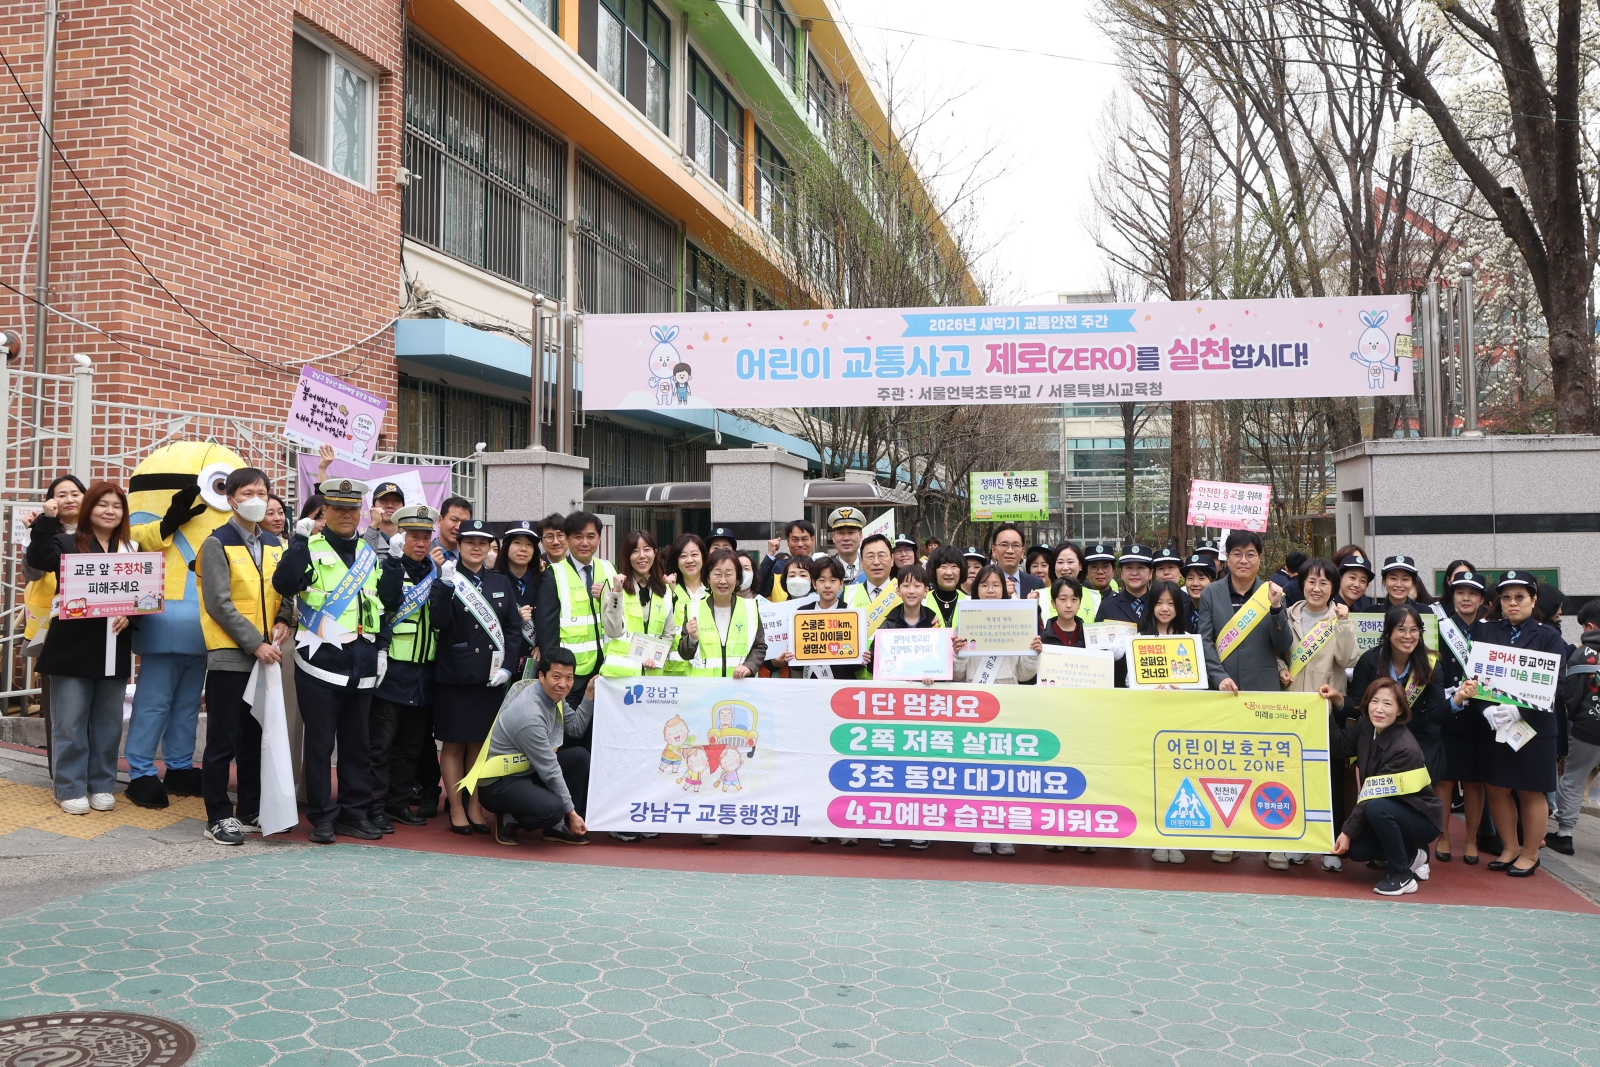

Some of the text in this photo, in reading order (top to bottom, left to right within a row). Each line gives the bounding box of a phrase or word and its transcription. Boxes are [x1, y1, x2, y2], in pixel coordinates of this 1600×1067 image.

[929, 314, 1108, 333] 2026년 새학기 교통안전 주간
[735, 337, 1309, 381] 어린이 교통사고 제로(ZERO)를 실천합시다!
[302, 385, 338, 411] 붕어빵엔
[877, 387, 905, 401] 주관
[918, 385, 1031, 401] 서울언북초등학교
[1048, 382, 1163, 398] 서울특별시교육청
[981, 478, 1004, 490] 정해진
[980, 493, 1040, 505] 안전등교 하세요.
[1199, 486, 1263, 501] 안전한 등교를 위해
[1196, 500, 1262, 515] 우리 모두 실천해요!
[74, 561, 153, 576] 교문 앞 주정차를
[88, 581, 139, 595] 피해주세요
[101, 605, 134, 613] 서울언북초등학교
[869, 592, 897, 622] 우리 사이
[801, 619, 852, 631] 스쿨존 30km,
[1217, 608, 1257, 655] 어린이 교통안전
[802, 630, 851, 643] 우리 아이들의
[893, 634, 930, 644] 걸어서 학교로!
[1291, 622, 1327, 661] 우리 아이 우리
[803, 643, 827, 655] 생명선
[890, 644, 933, 655] 건강에도 좋아요!
[1138, 644, 1166, 655] 멈춰요!
[1299, 642, 1319, 663] 지켜요
[1140, 656, 1168, 667] 살펴요!
[1488, 650, 1556, 671] 걸어서 등교하면
[1141, 668, 1169, 679] 건너요!
[1474, 662, 1554, 686] 몸 튼튼! 마음 튼튼!
[646, 686, 679, 698] 강남구
[1519, 692, 1551, 702] 서울언북초등학교
[852, 690, 980, 719] 1단 멈춰요
[1255, 711, 1274, 719] 미래를
[1289, 709, 1307, 720] 강남
[849, 726, 1040, 757] 2쪽 저쪽 살펴요
[1167, 738, 1291, 758] 어린이보호구역
[1172, 758, 1285, 772] SCHOOL ZONE
[848, 763, 1069, 795] 3초 동안 대기해요
[1214, 786, 1238, 796] 천천히
[1257, 801, 1290, 811] 주정차금지
[629, 802, 801, 827] 강남구 교통행정과
[845, 799, 1120, 835] 4고예방 습관을 키워요
[1170, 819, 1206, 827] 어린이보호
